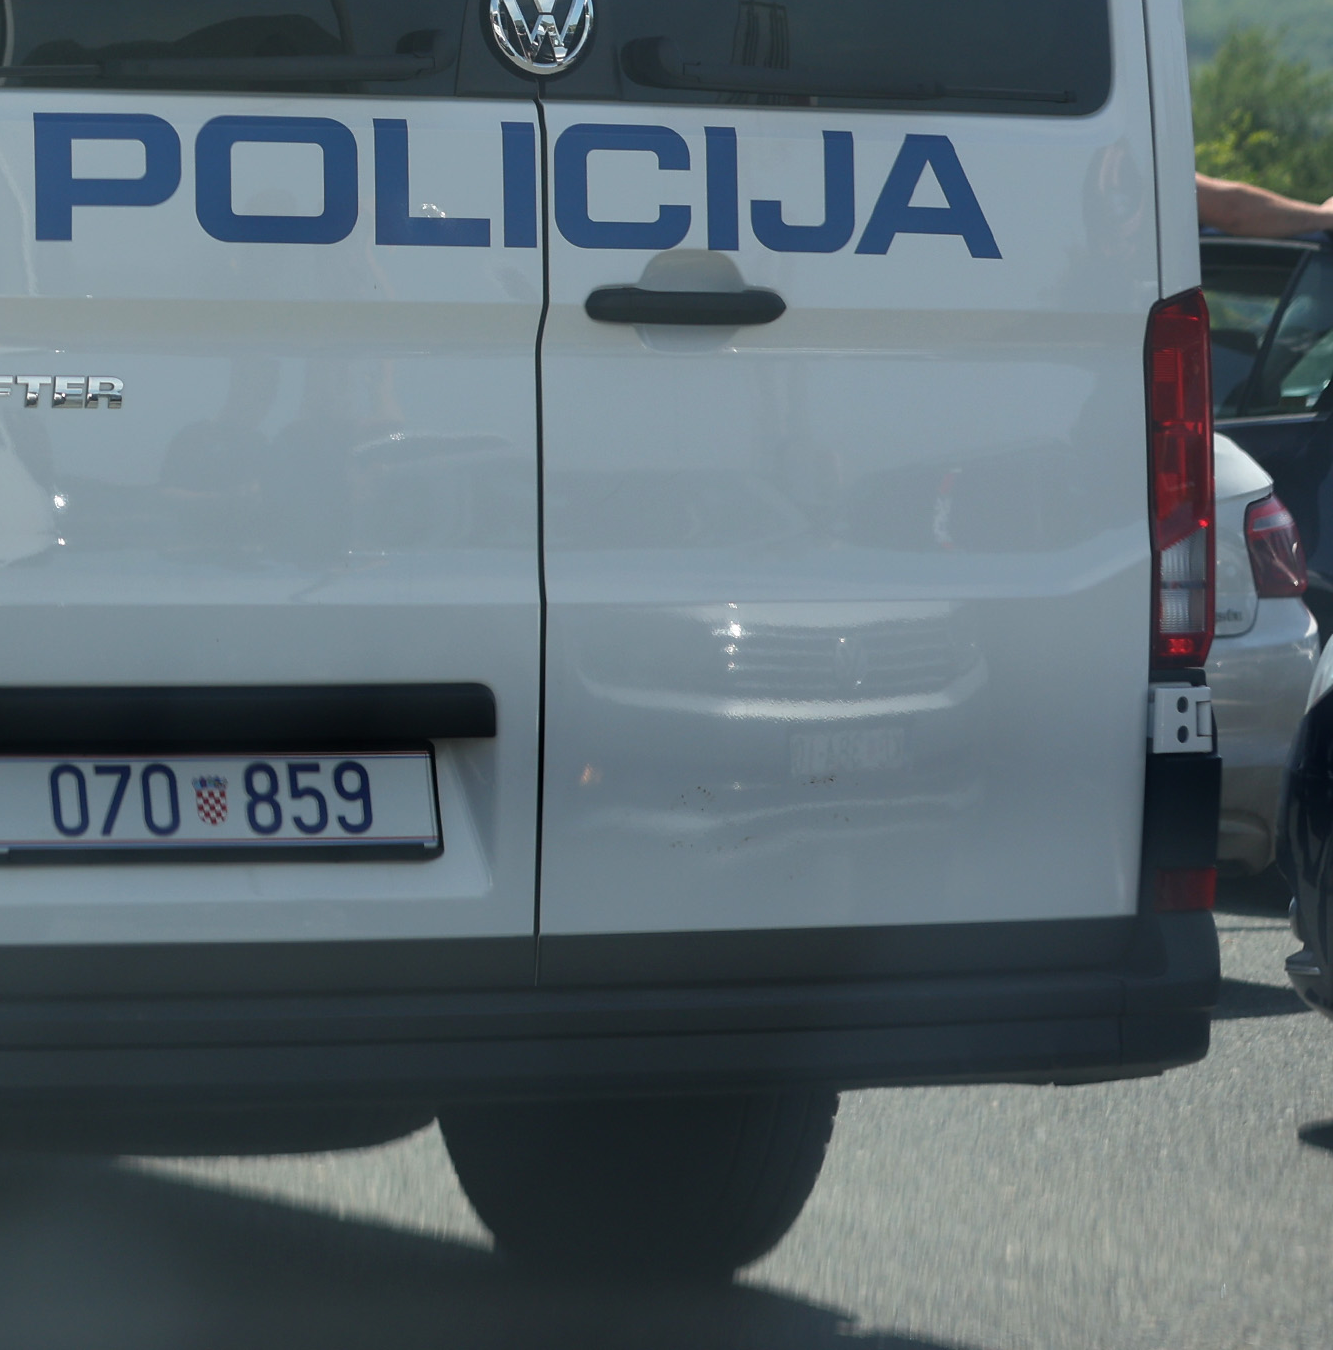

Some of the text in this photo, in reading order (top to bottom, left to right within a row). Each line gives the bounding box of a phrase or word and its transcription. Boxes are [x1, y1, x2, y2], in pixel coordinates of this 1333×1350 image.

[33, 112, 1003, 259] POLICIJA
[48, 760, 374, 837] 070 859
